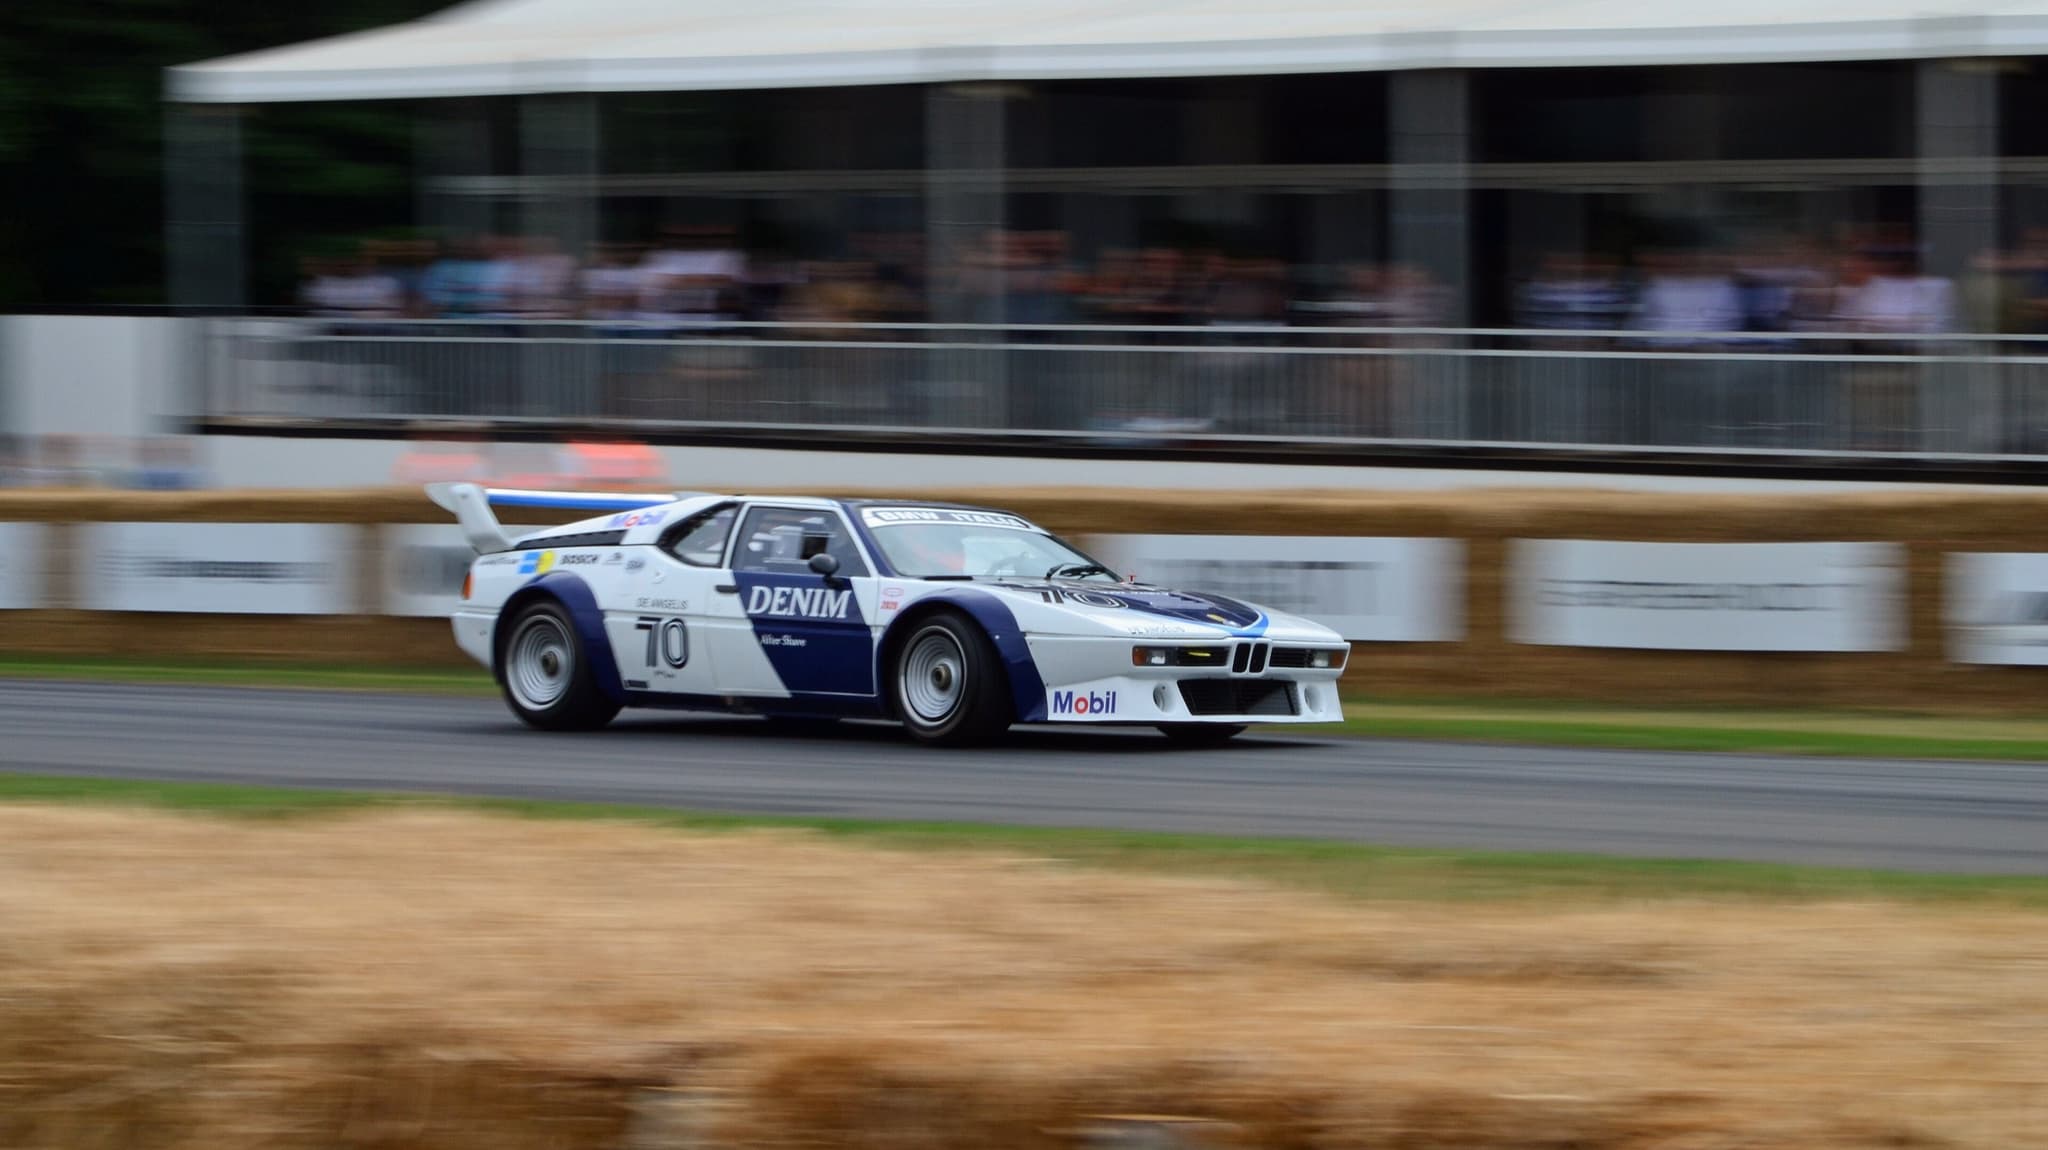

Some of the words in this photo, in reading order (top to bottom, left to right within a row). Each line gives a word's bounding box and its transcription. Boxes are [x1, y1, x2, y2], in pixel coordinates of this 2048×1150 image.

[608, 510, 669, 528] Mobil
[878, 511, 940, 521] BMW
[952, 513, 1024, 528] ITALIA
[560, 554, 600, 566] BOSCH
[747, 585, 852, 619] DENIM
[635, 616, 689, 669] 70
[1053, 691, 1116, 714] Mobil
